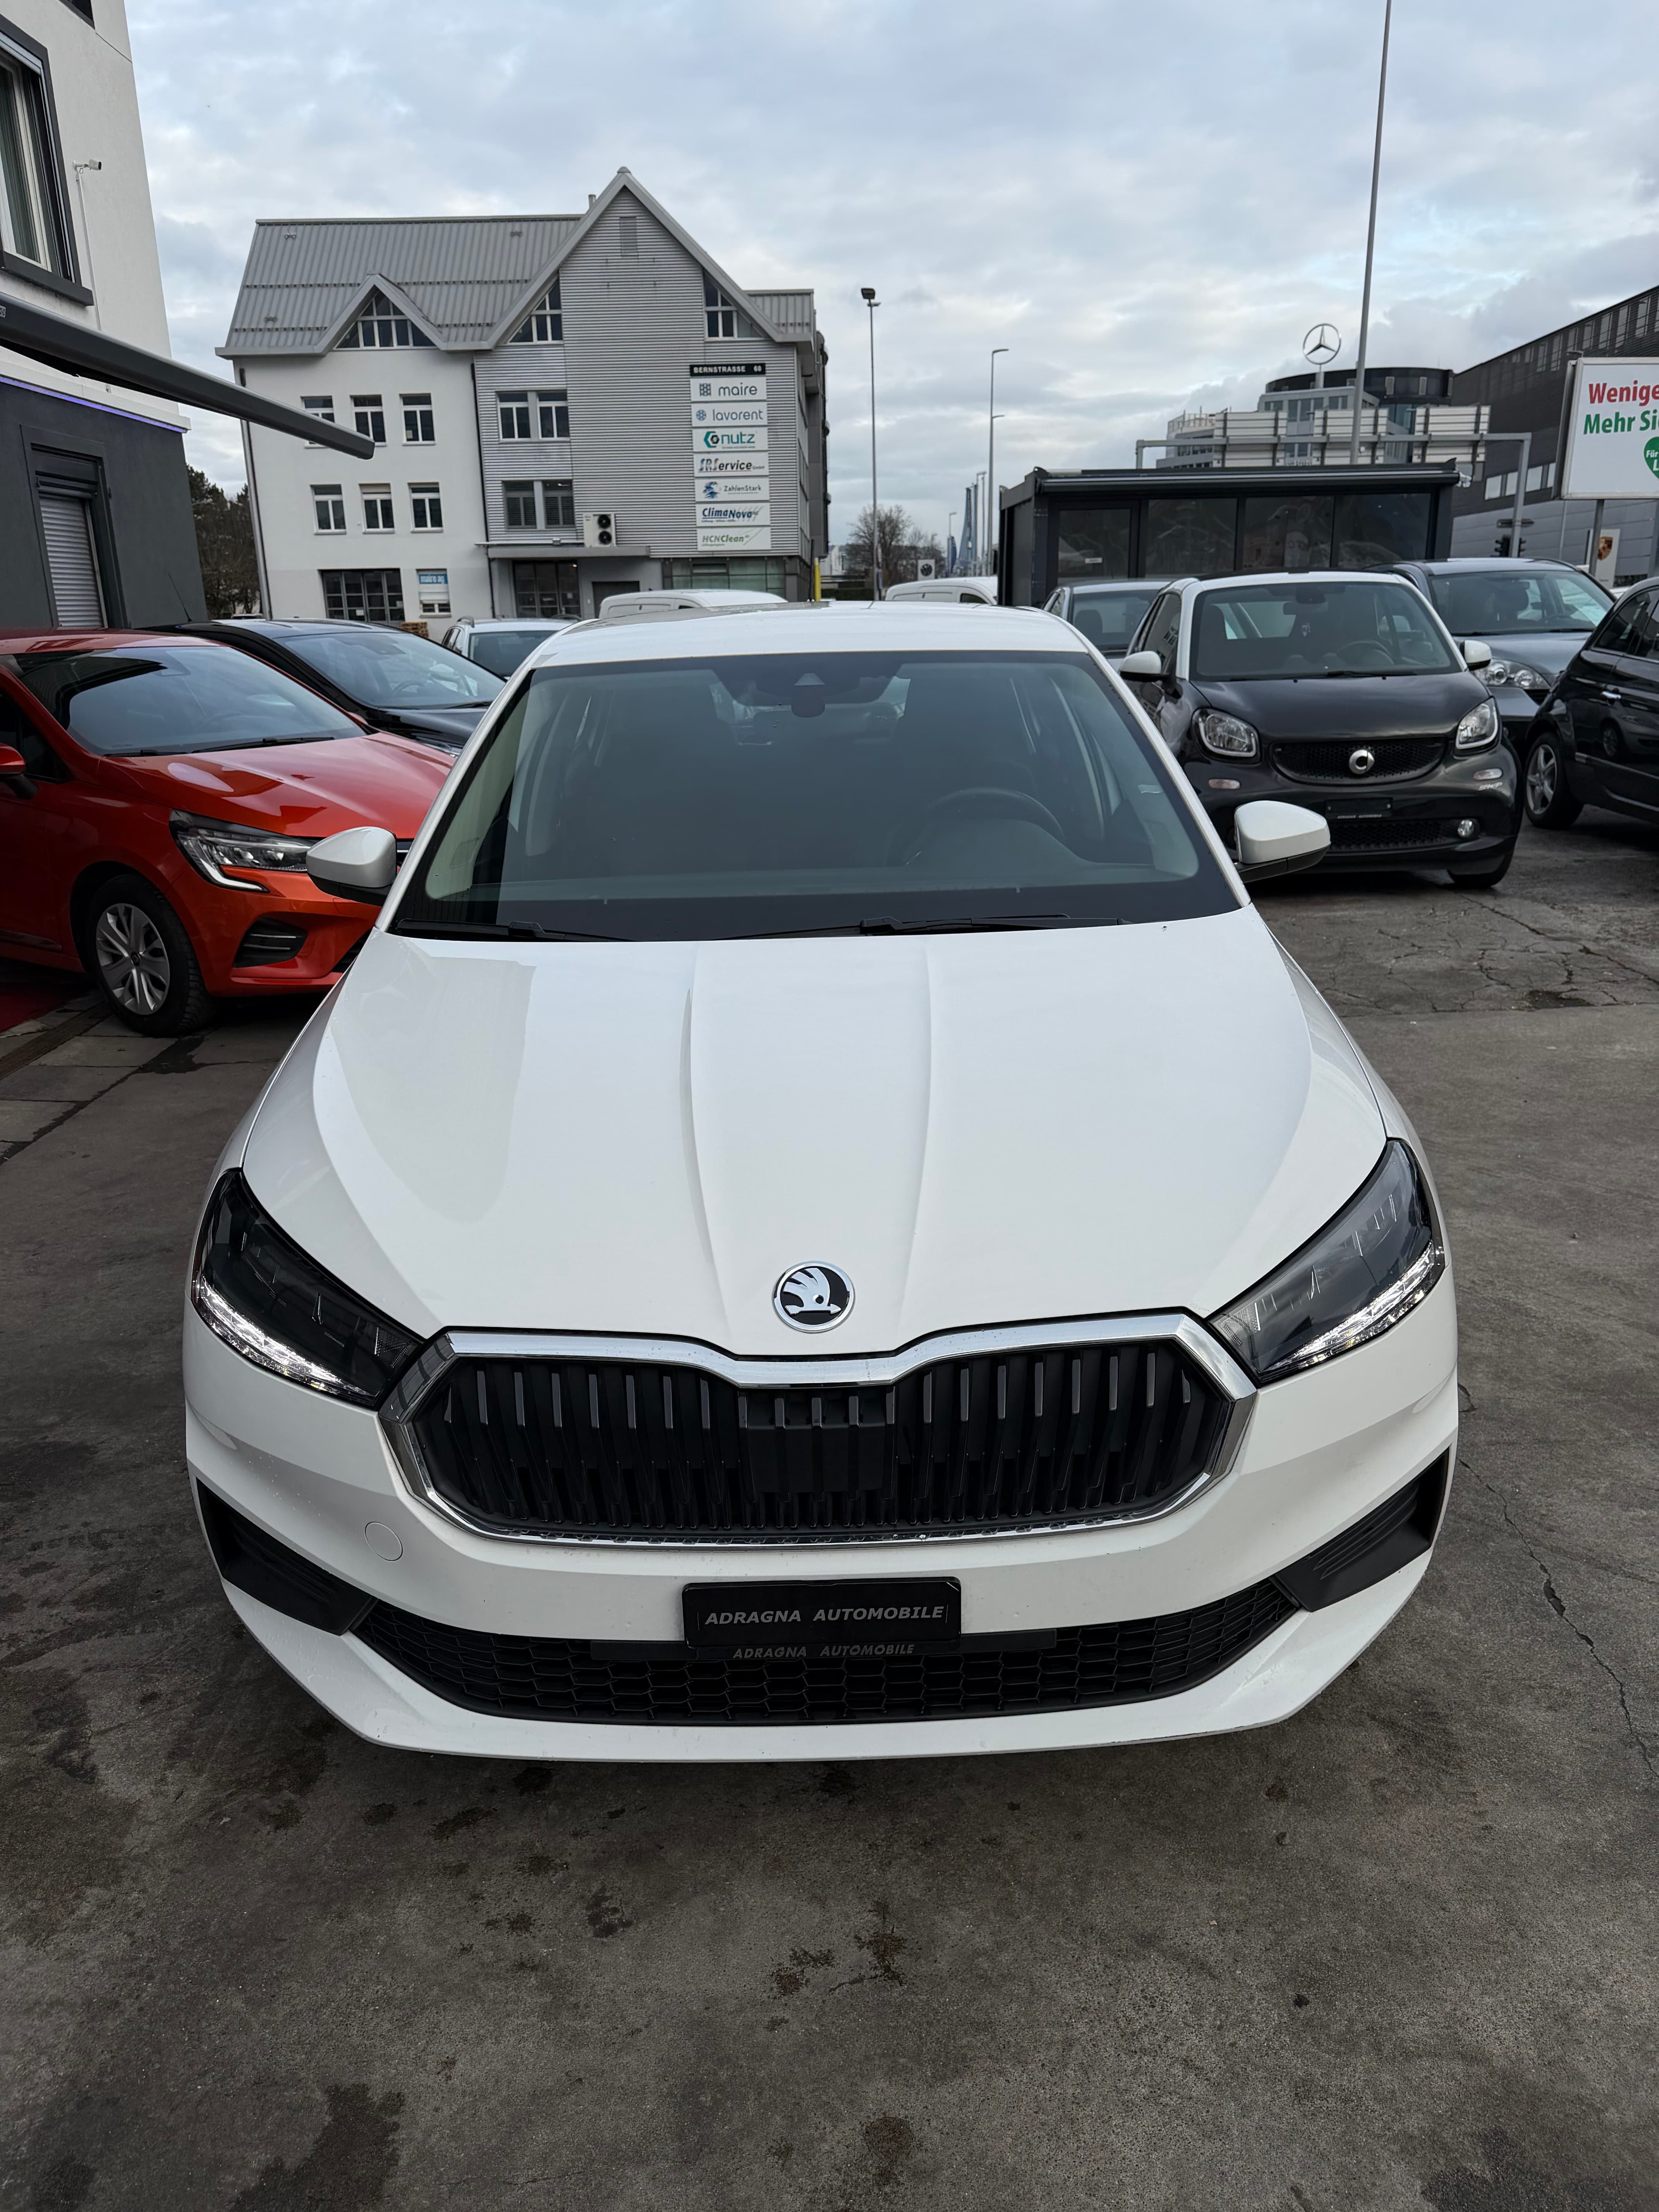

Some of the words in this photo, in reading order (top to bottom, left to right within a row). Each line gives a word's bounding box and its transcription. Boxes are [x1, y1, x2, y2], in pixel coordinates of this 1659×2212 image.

[718, 382, 757, 396] maire
[712, 409, 764, 421] lavorent
[1583, 412, 1636, 435] Mehr
[1639, 409, 1659, 431] Si
[1646, 450, 1659, 458] Für
[702, 508, 752, 519] ClimaNova
[704, 1610, 801, 1625] ADRAGNA
[813, 1606, 944, 1621] AUTOMOBILE
[733, 1646, 807, 1659] ADRAGNA
[820, 1644, 915, 1657] AUTOMOBILE
